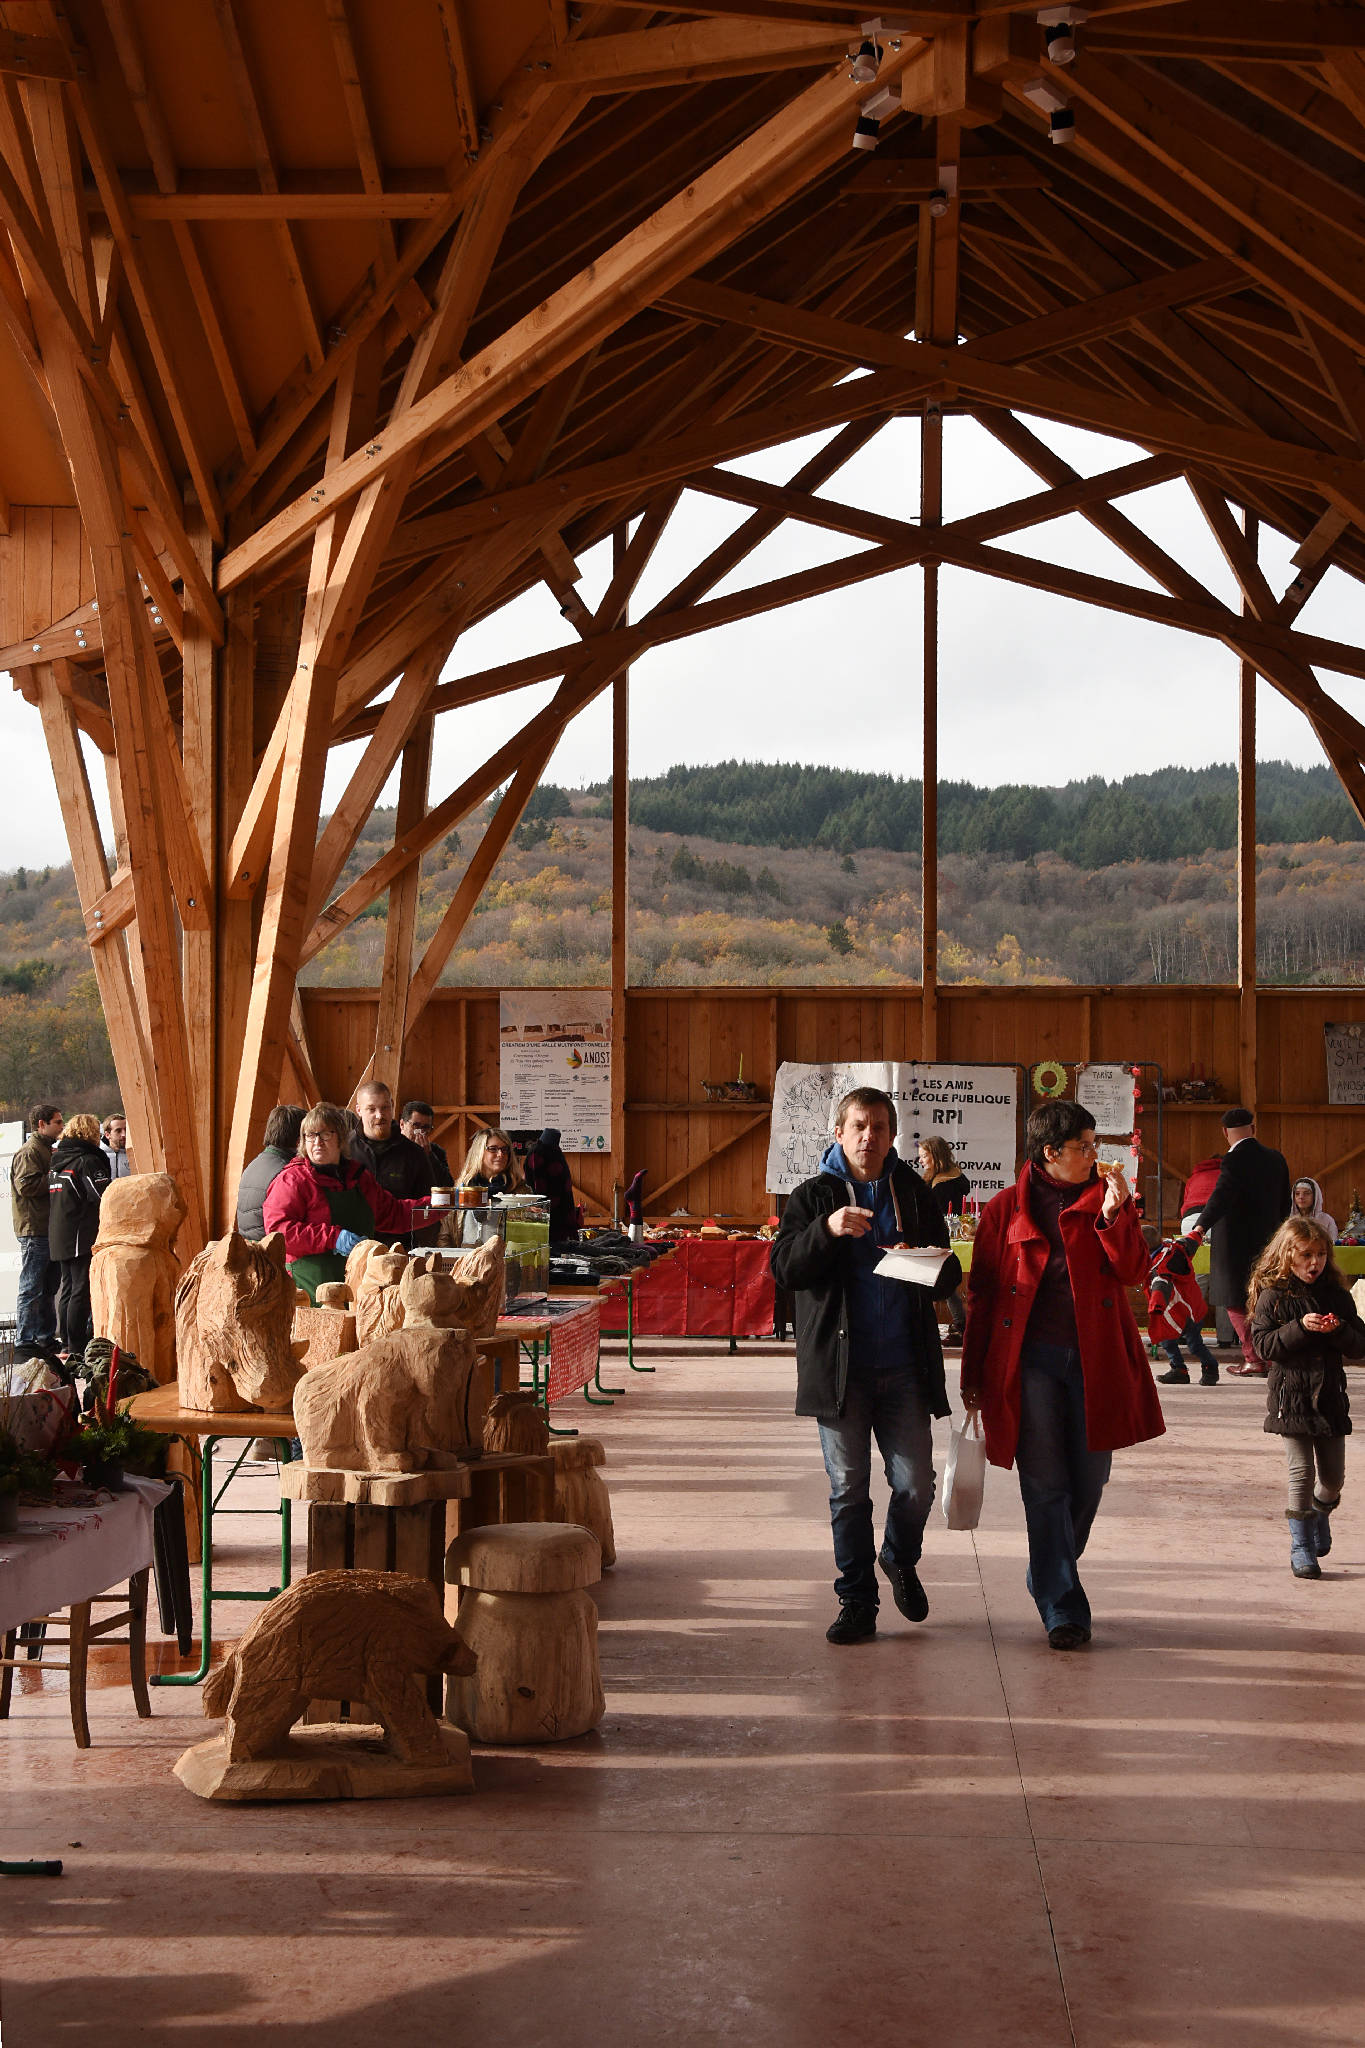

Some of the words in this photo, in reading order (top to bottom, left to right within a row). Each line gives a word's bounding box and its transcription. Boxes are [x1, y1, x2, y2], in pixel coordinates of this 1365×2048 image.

[583, 1051, 610, 1064] ANOST
[1335, 1050, 1365, 1067] SAP
[923, 1079, 942, 1089] LES
[945, 1080, 974, 1090] AMIS
[1337, 1080, 1365, 1091] ANOS
[951, 1094, 1011, 1105] PUBLIQUE
[932, 1108, 963, 1124] RPI
[970, 1180, 1005, 1190] RIERE
